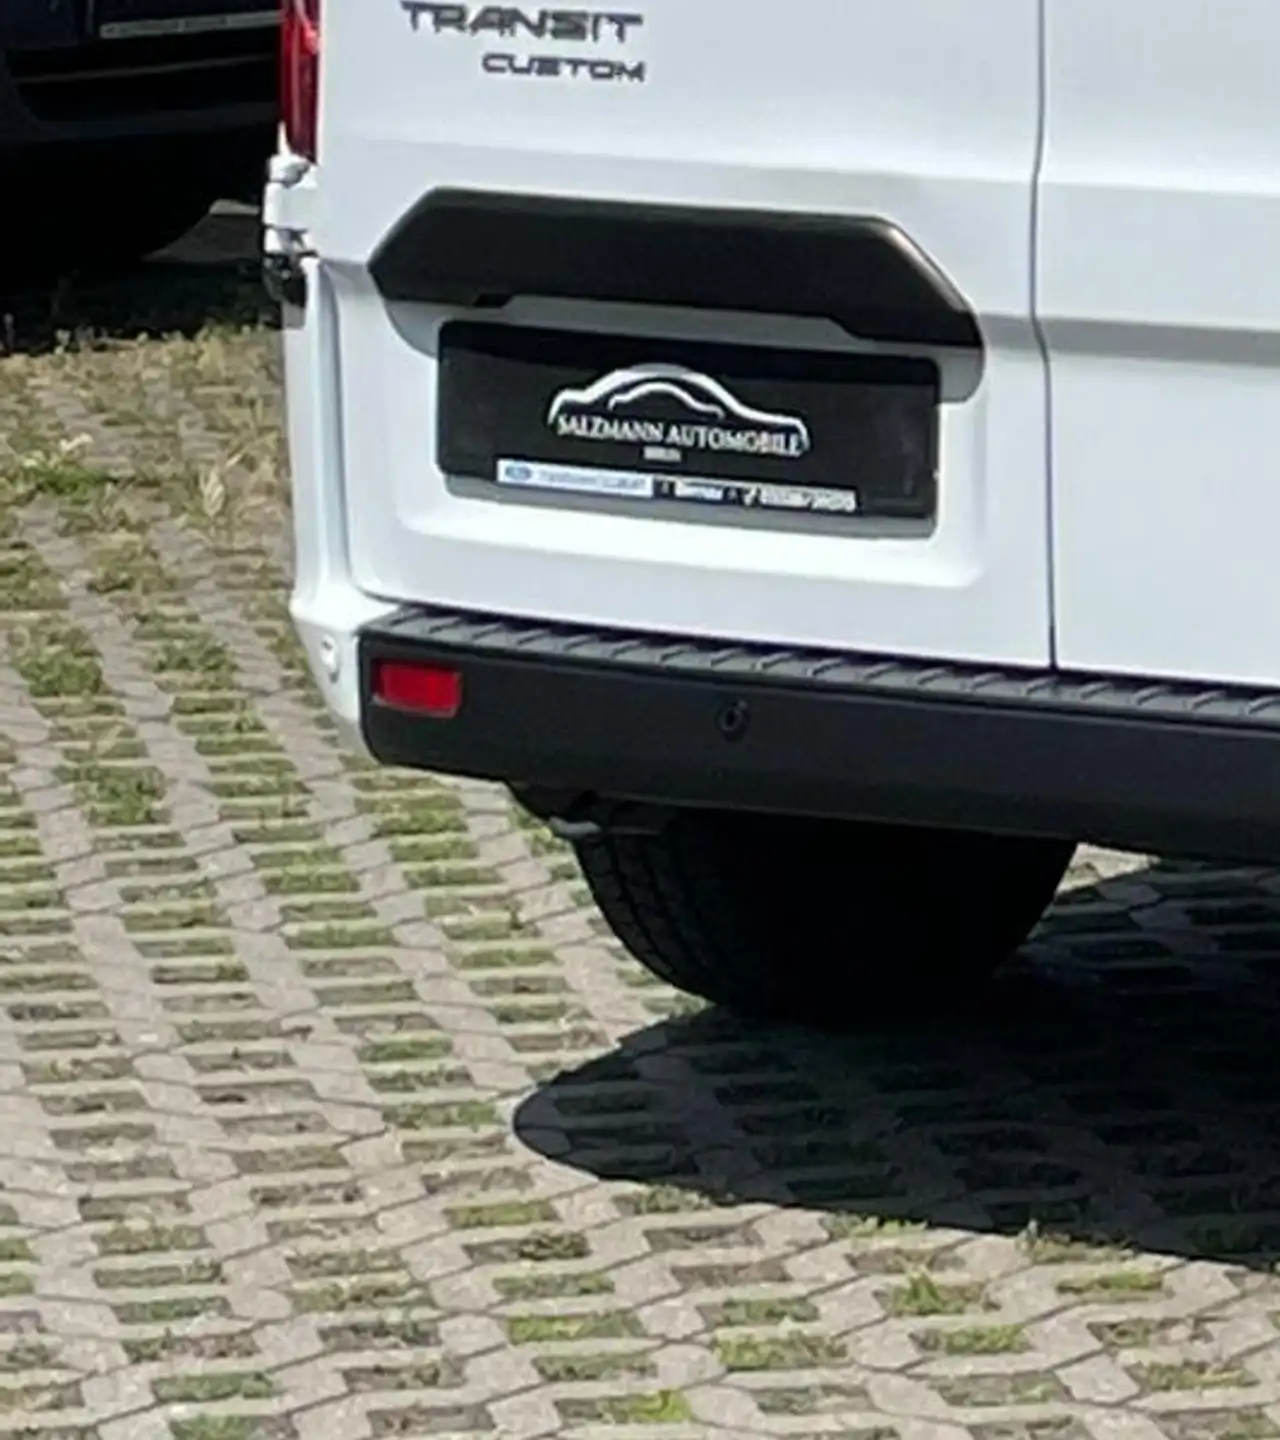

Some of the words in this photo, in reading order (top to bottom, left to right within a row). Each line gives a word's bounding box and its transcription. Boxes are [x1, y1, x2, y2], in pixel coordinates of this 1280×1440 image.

[399, 0, 643, 43] TRANSIT
[482, 53, 645, 82] CUSTOM
[557, 414, 664, 444] SALZMANN
[665, 422, 803, 458] AUTOMOBILE
